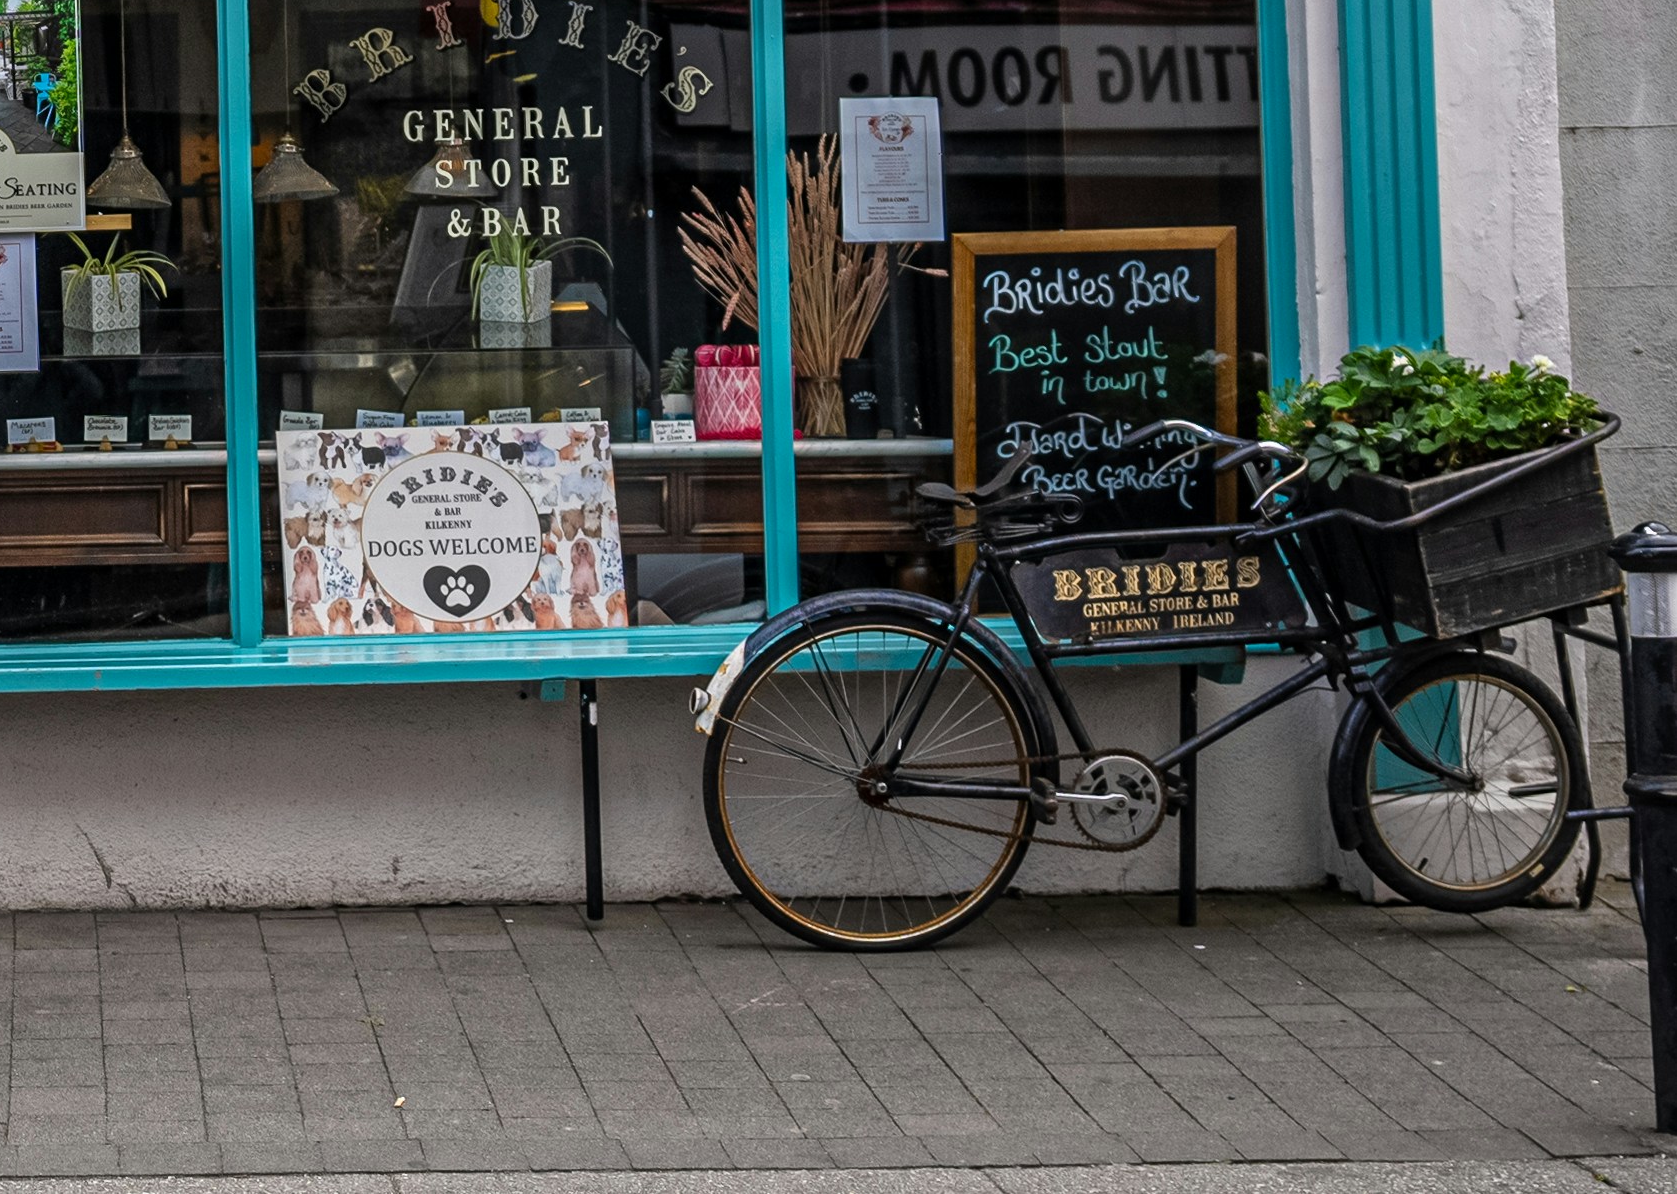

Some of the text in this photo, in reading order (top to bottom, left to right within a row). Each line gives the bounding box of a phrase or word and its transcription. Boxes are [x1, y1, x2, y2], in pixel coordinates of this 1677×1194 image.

[403, 106, 603, 142] GENERAL
[435, 157, 570, 190] STORE
[988, 326, 1168, 374] Best Stout
[1041, 366, 1168, 404] in town!
[386, 466, 509, 508] BRIDIE'S
[411, 493, 482, 504] GENERAL STORE
[425, 520, 472, 530] KILKENNY
[434, 507, 461, 516] & BAR
[368, 536, 537, 557] DOGS WELCOME
[1053, 556, 1261, 601] BRIDIES
[1083, 592, 1240, 618] GENERAL STORE & BAR
[1090, 612, 1235, 636] KILKENNY IRELAND
